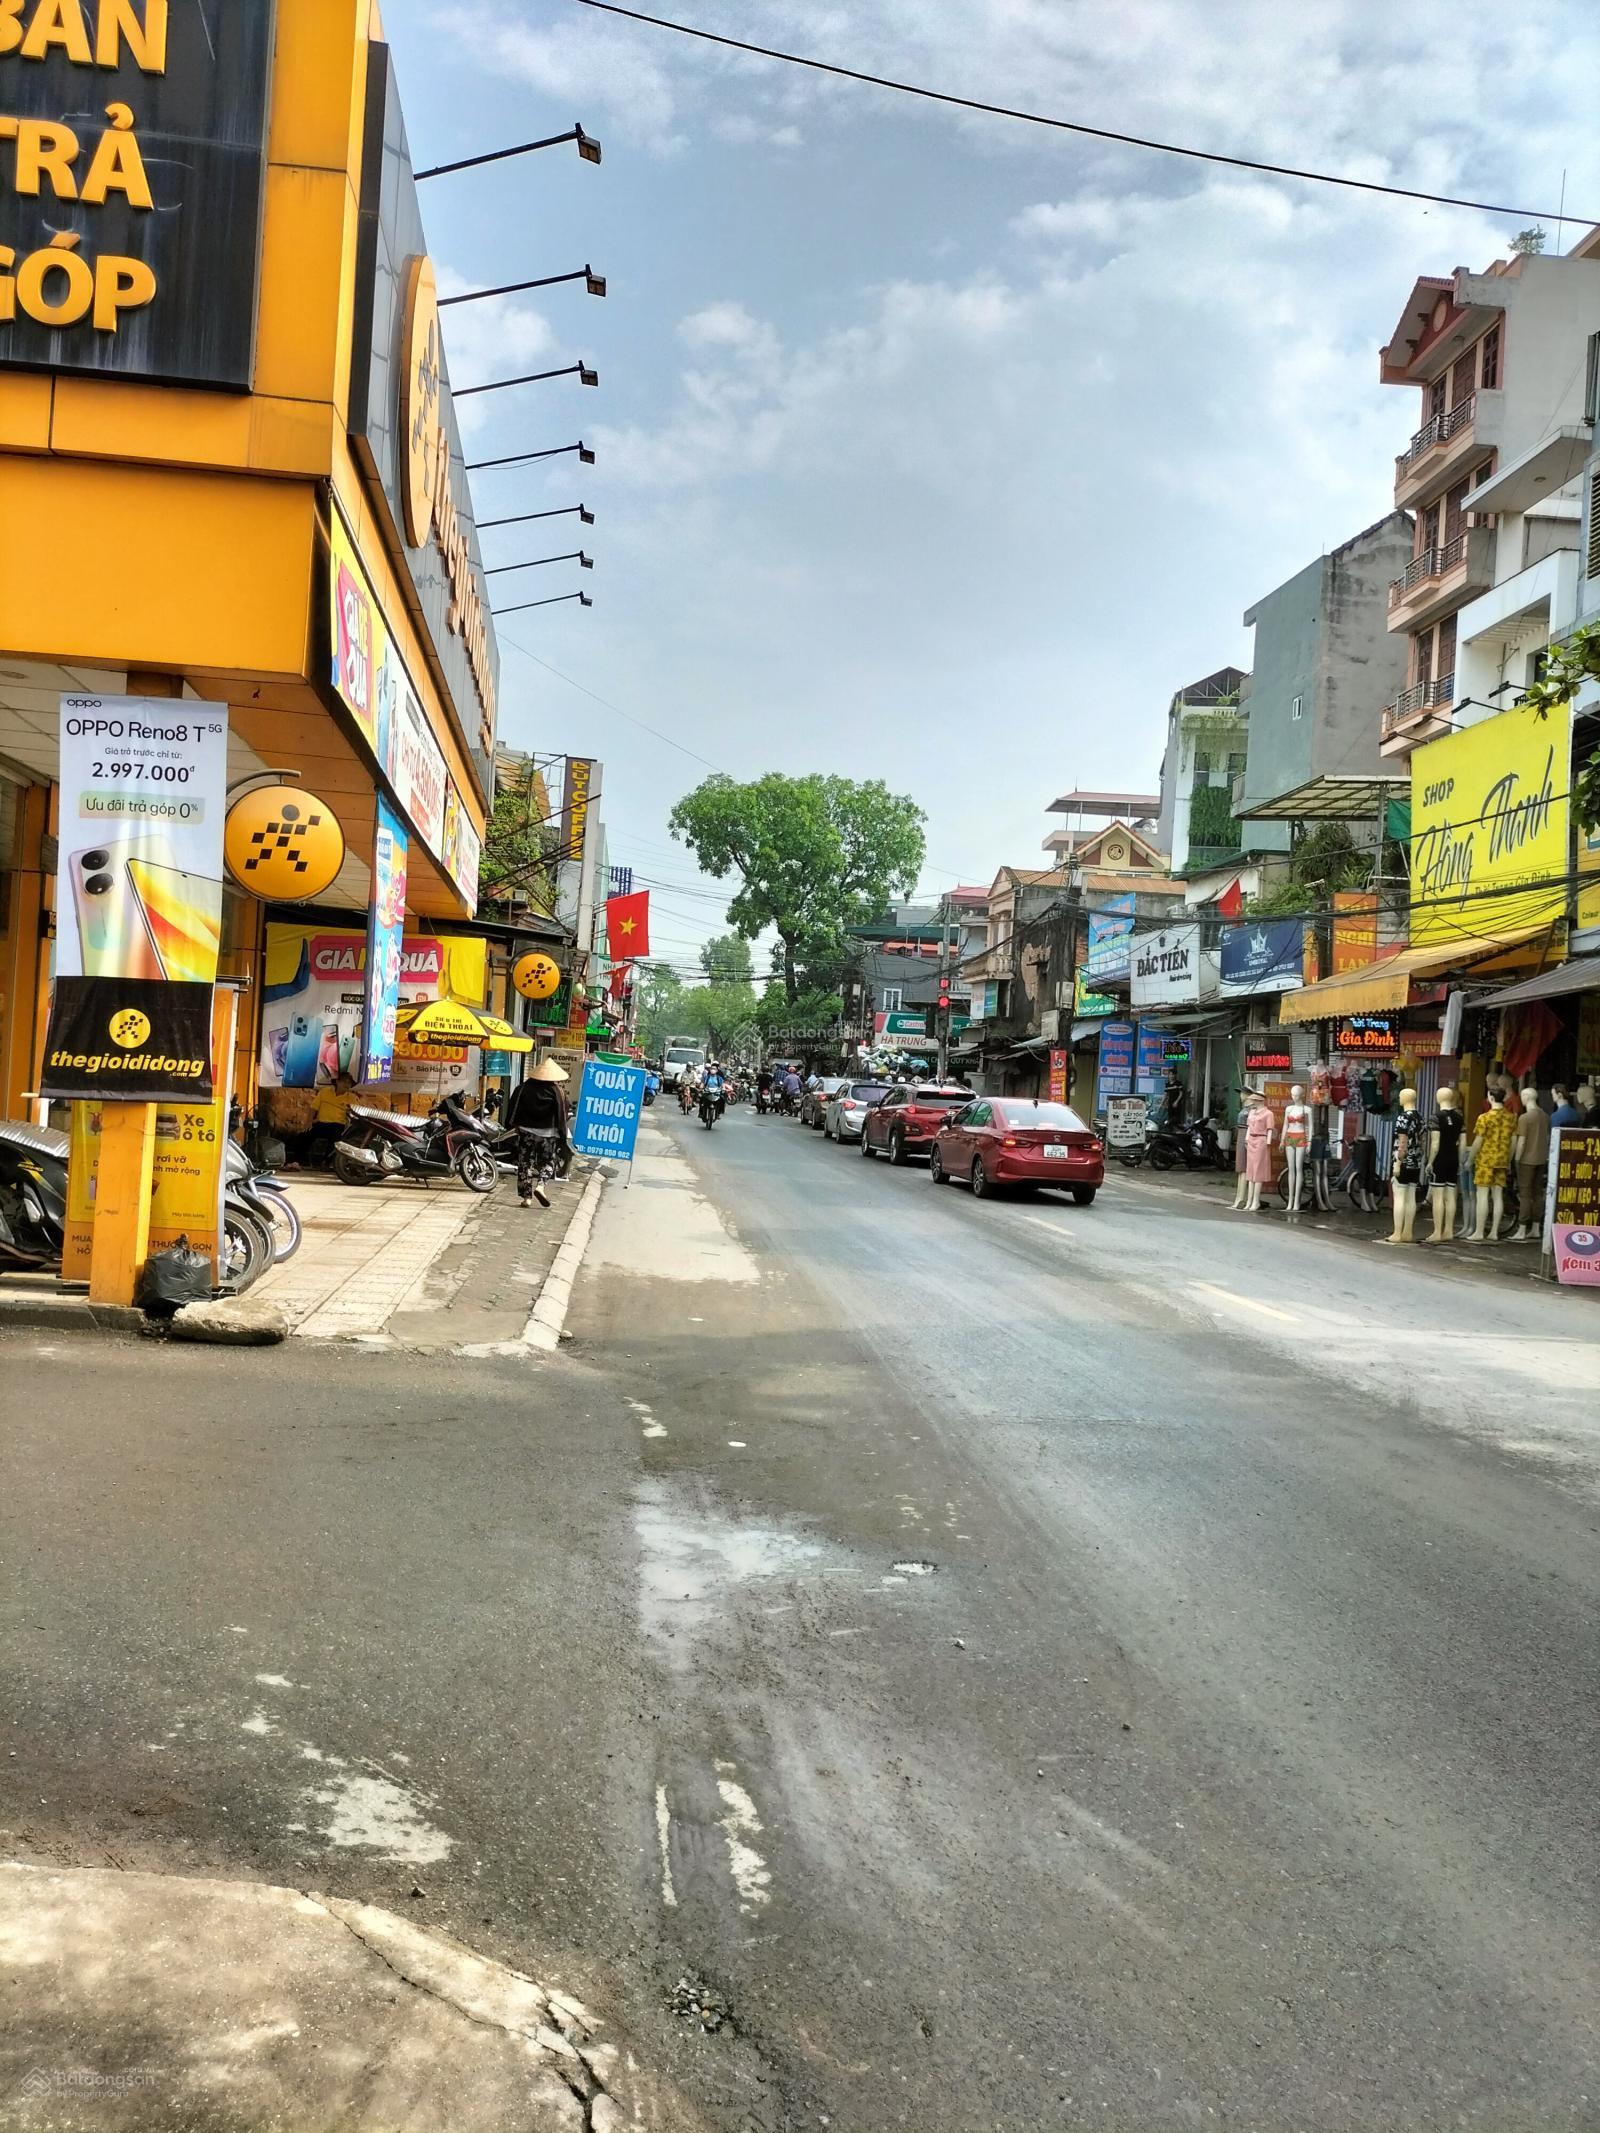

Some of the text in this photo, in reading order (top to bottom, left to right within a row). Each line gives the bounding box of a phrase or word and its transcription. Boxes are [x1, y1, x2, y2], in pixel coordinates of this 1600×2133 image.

[66, 718, 223, 743] OPPO Reno8 T 5G
[92, 762, 189, 783] 2.997.000
[1423, 777, 1455, 807] SHOP
[86, 797, 104, 812] Ưu
[128, 798, 147, 813] trả
[149, 801, 176, 818] góp
[1480, 744, 1554, 864] Thanh
[315, 947, 357, 970] GIÁ
[324, 1004, 354, 1015] Redmi
[896, 1036, 927, 1047] TRUNG
[1340, 1031, 1362, 1046] Gia
[50, 1051, 205, 1077] thegioididong
[594, 1068, 637, 1092] QUẦY
[585, 1096, 636, 1119] THUỐC
[183, 1114, 205, 1127] Xe
[197, 1129, 216, 1142] tô
[587, 1123, 625, 1144] KHÔI
